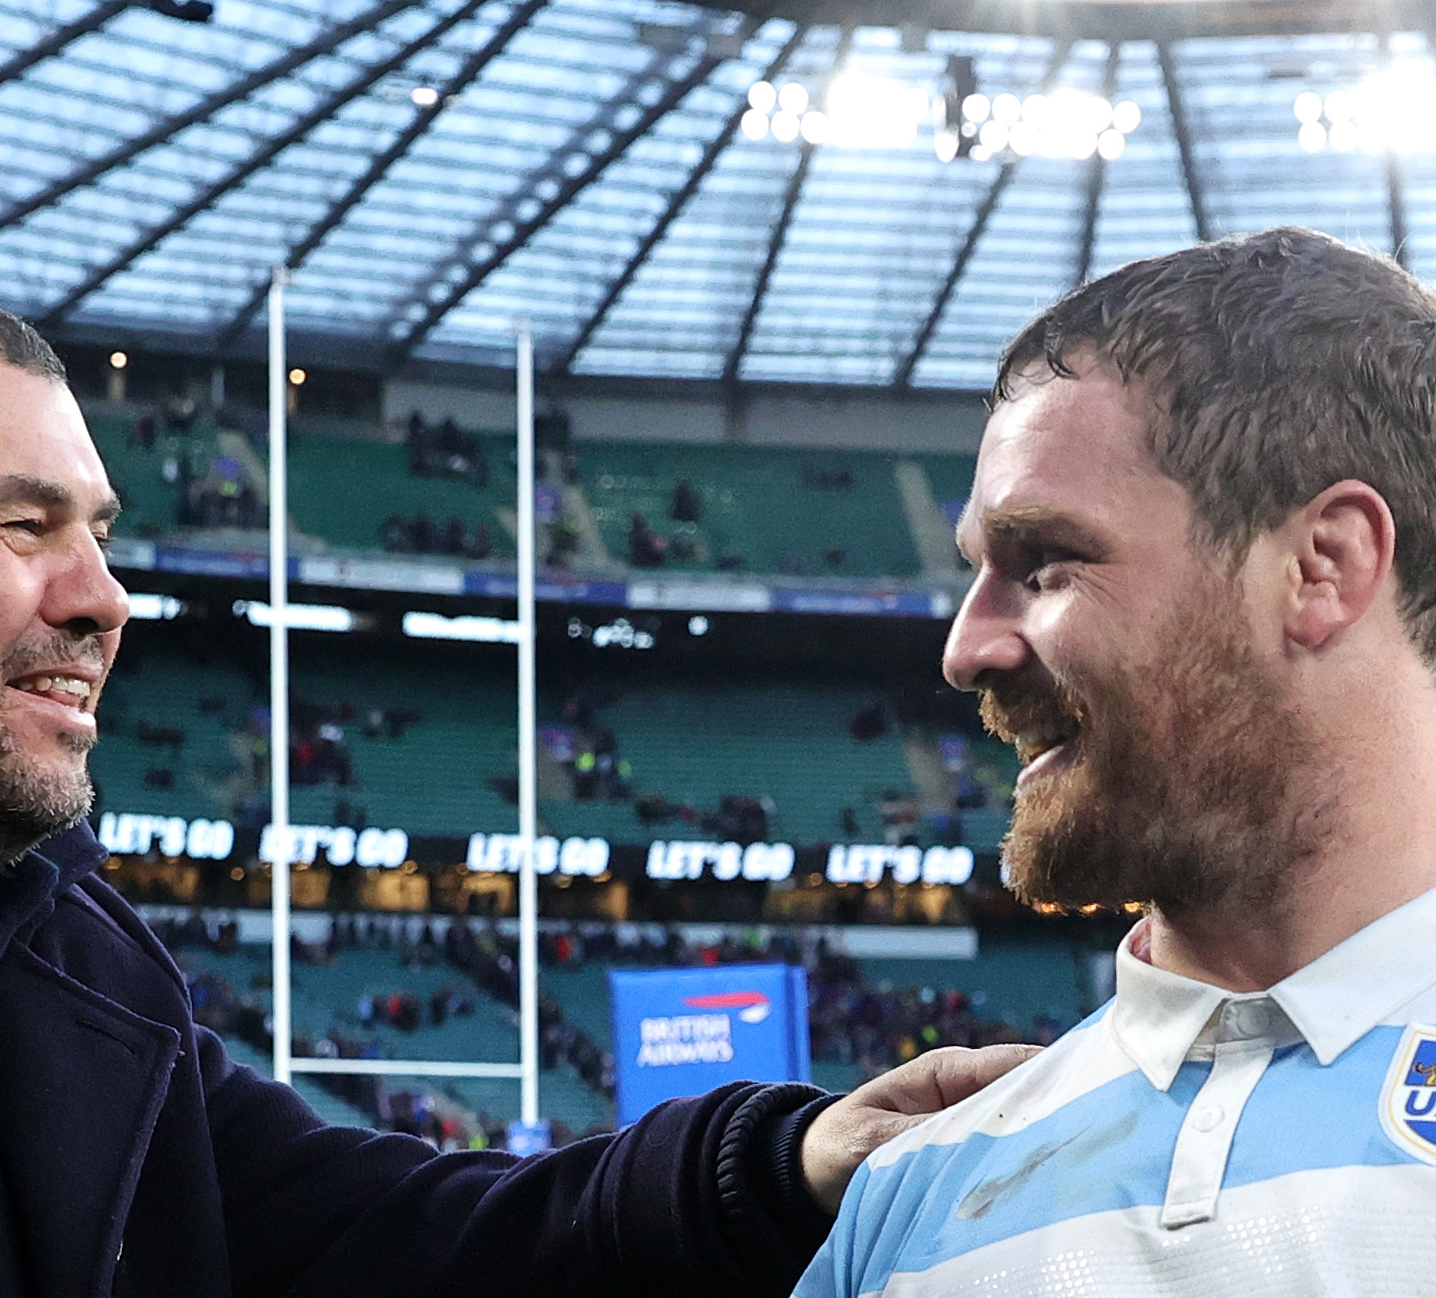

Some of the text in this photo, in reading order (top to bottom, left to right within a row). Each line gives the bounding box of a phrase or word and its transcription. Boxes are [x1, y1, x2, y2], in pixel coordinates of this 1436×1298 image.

[98, 811, 234, 860] LET'S GO
[356, 827, 409, 868] GO
[559, 836, 610, 877] GO
[646, 840, 795, 882] LET'S GO
[827, 844, 975, 887] LET'S GO
